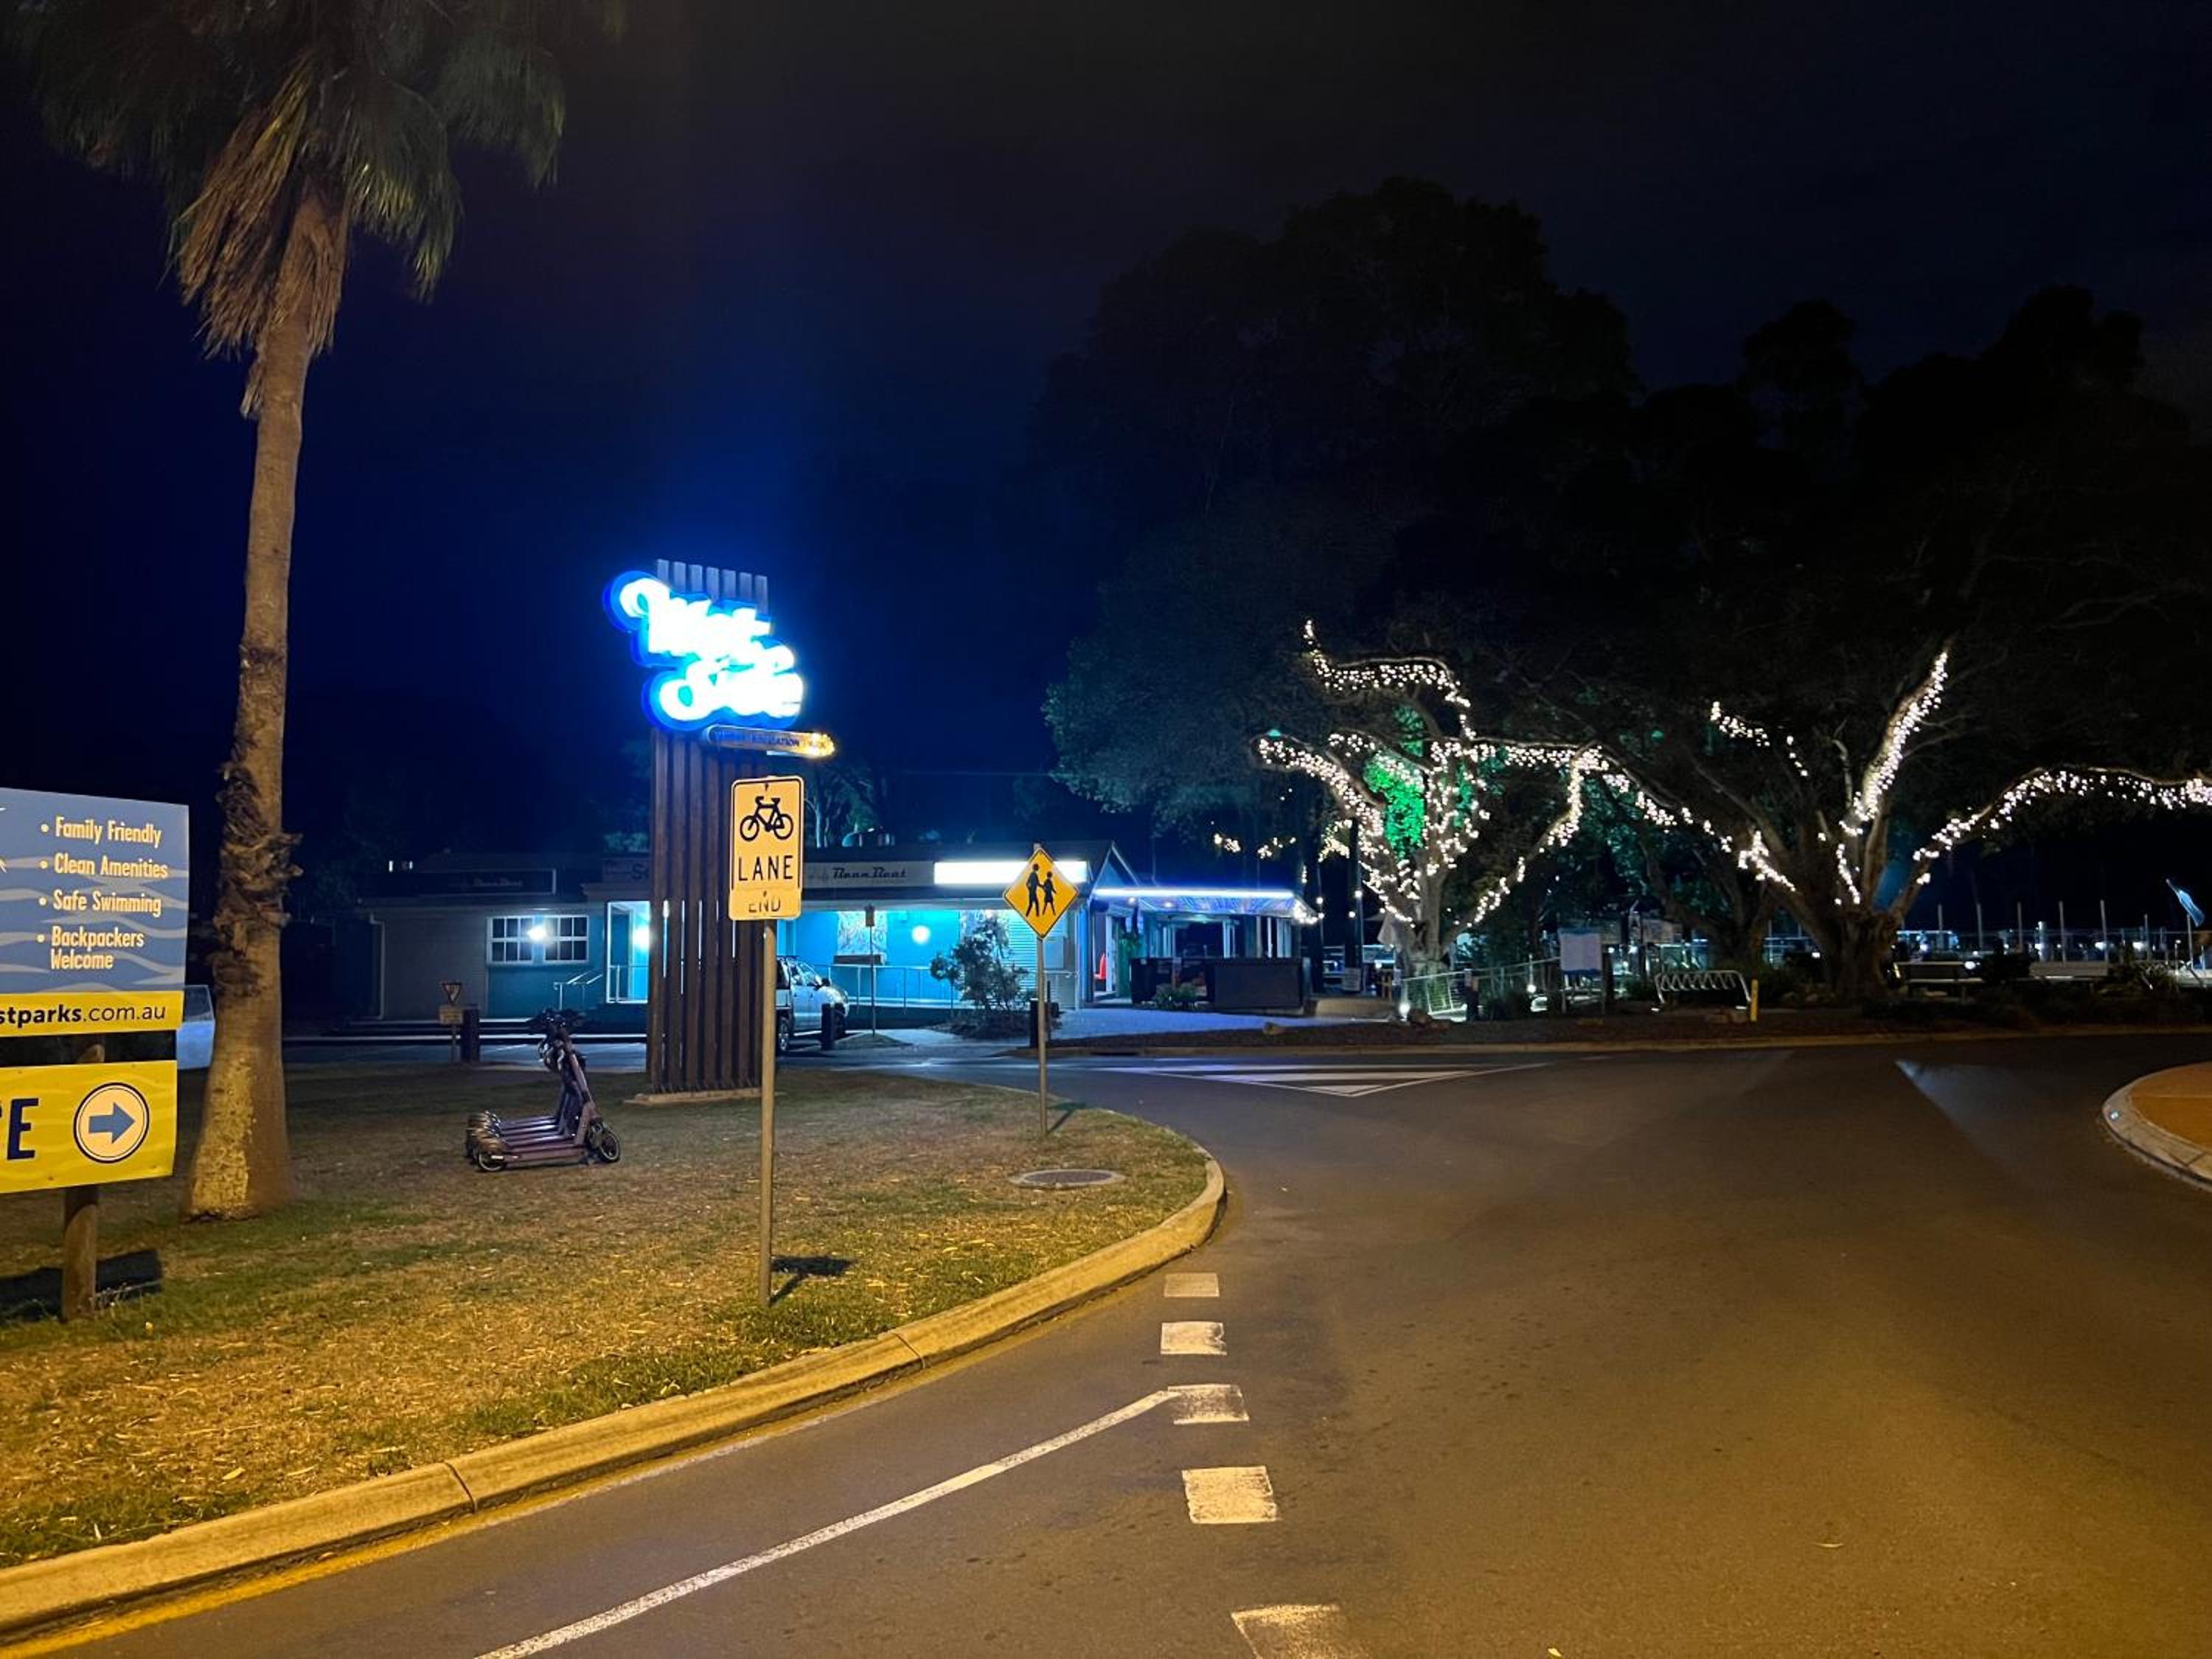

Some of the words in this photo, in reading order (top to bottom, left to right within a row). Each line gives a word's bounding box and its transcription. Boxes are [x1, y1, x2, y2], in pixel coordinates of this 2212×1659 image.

[55, 816, 102, 844] Family
[108, 820, 161, 848] Friendly
[54, 853, 95, 875] Clean
[100, 855, 168, 878] Amenities
[739, 855, 793, 880] LANE
[53, 889, 87, 911] Safe
[92, 891, 161, 917] Swimming
[748, 898, 781, 913] END
[52, 926, 145, 952] Backpackers
[51, 948, 114, 970] Welcome
